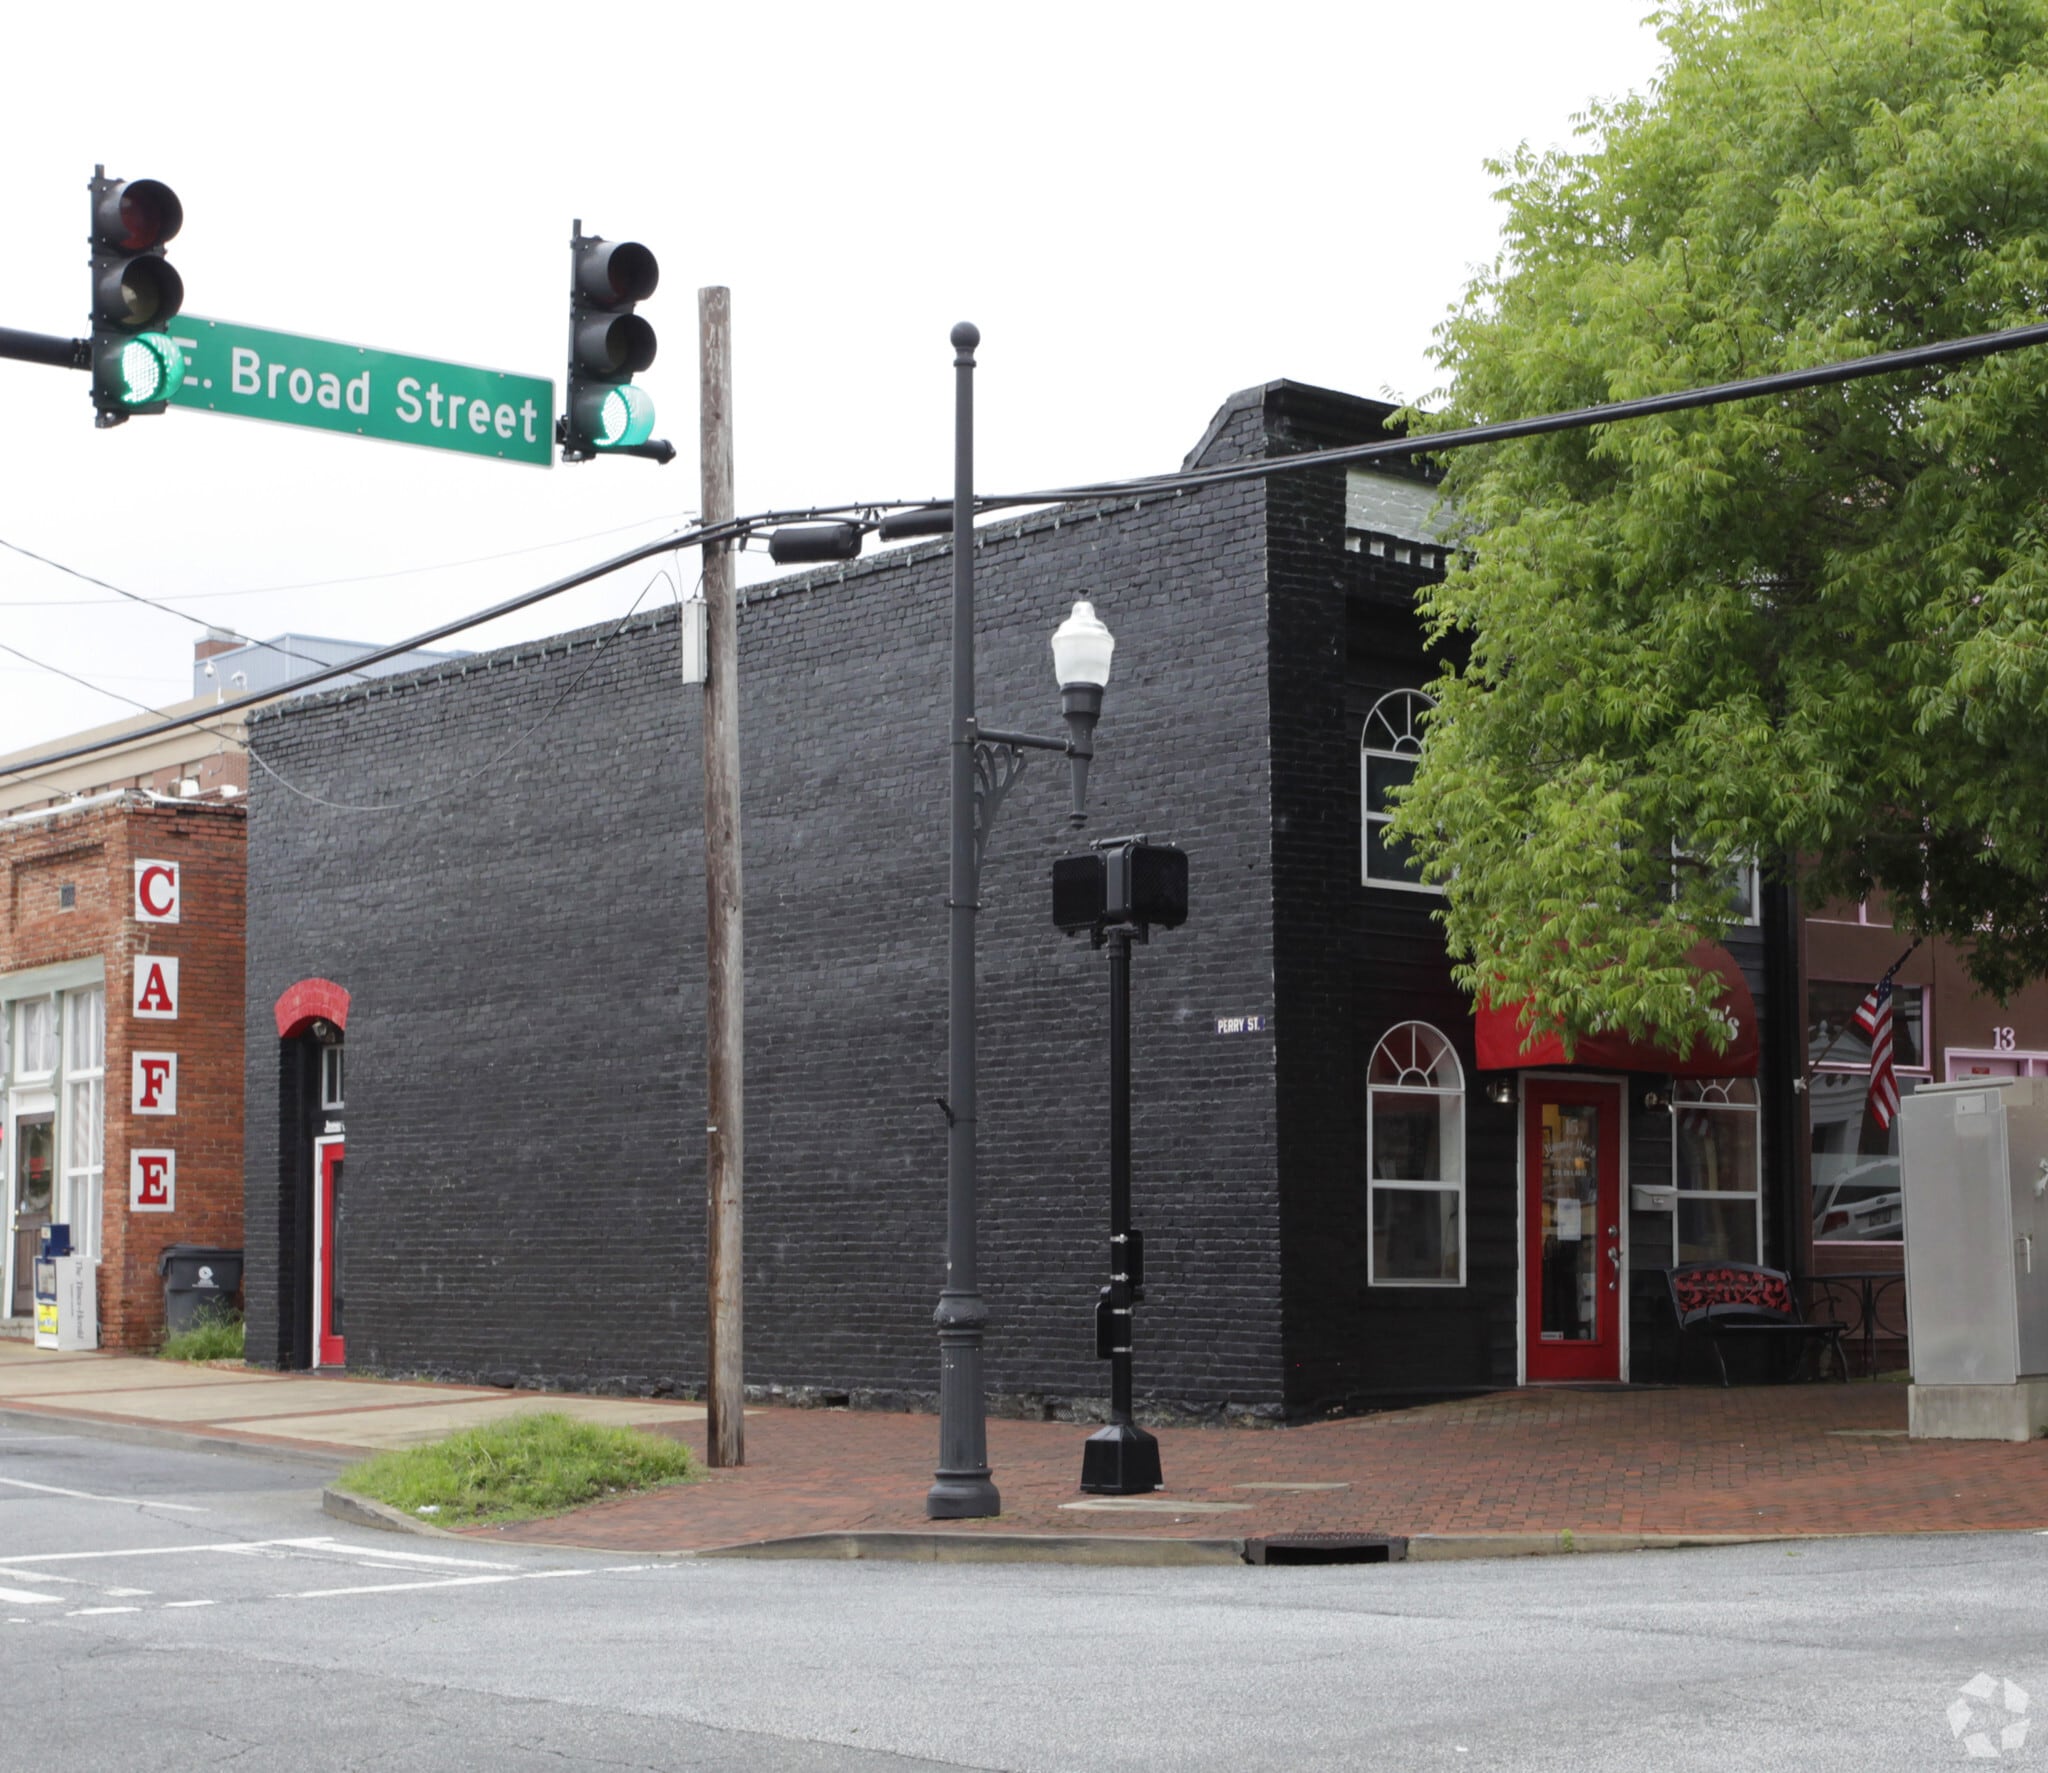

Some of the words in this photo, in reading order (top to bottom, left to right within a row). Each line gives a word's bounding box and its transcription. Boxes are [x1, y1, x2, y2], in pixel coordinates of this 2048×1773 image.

[231, 346, 370, 415] Broad
[395, 376, 537, 443] Street
[137, 865, 176, 1205] CAFE
[1217, 1017, 1245, 1034] PERRY
[1992, 1026, 2016, 1051] 13
